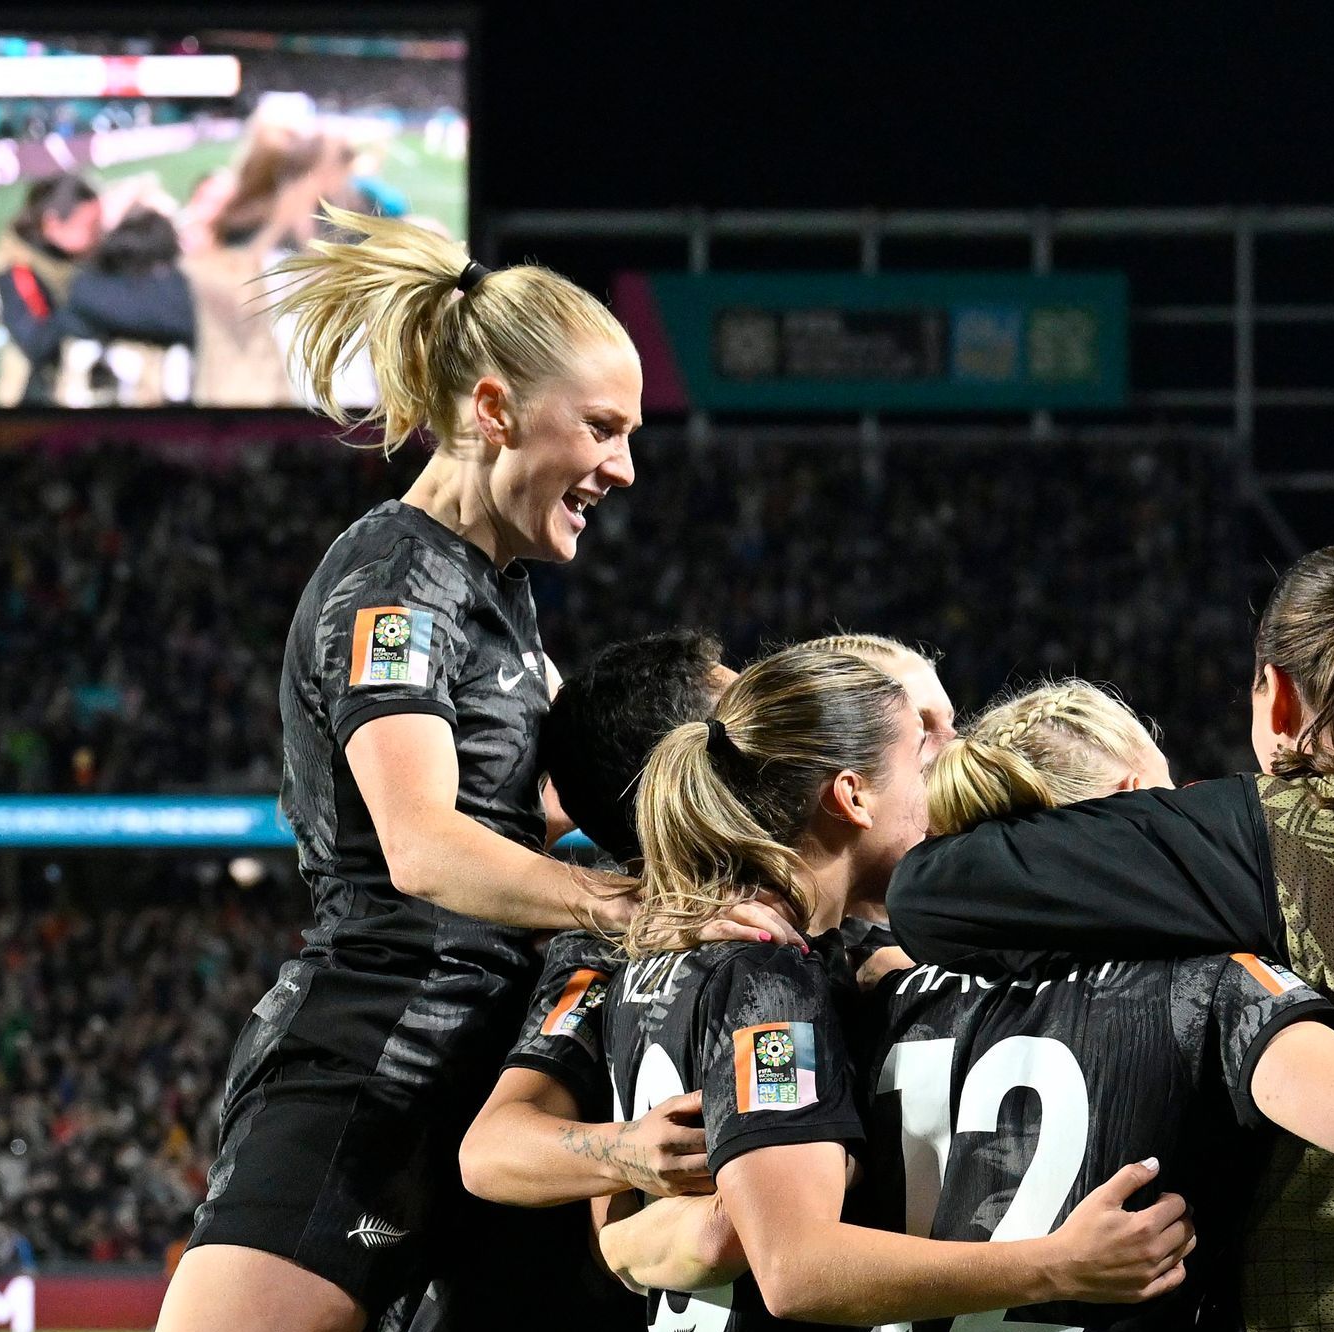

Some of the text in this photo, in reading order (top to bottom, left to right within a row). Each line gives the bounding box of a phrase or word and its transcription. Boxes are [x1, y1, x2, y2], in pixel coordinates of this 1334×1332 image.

[759, 1085, 796, 1094] AU 20
[759, 1093, 796, 1102] NZ 23
